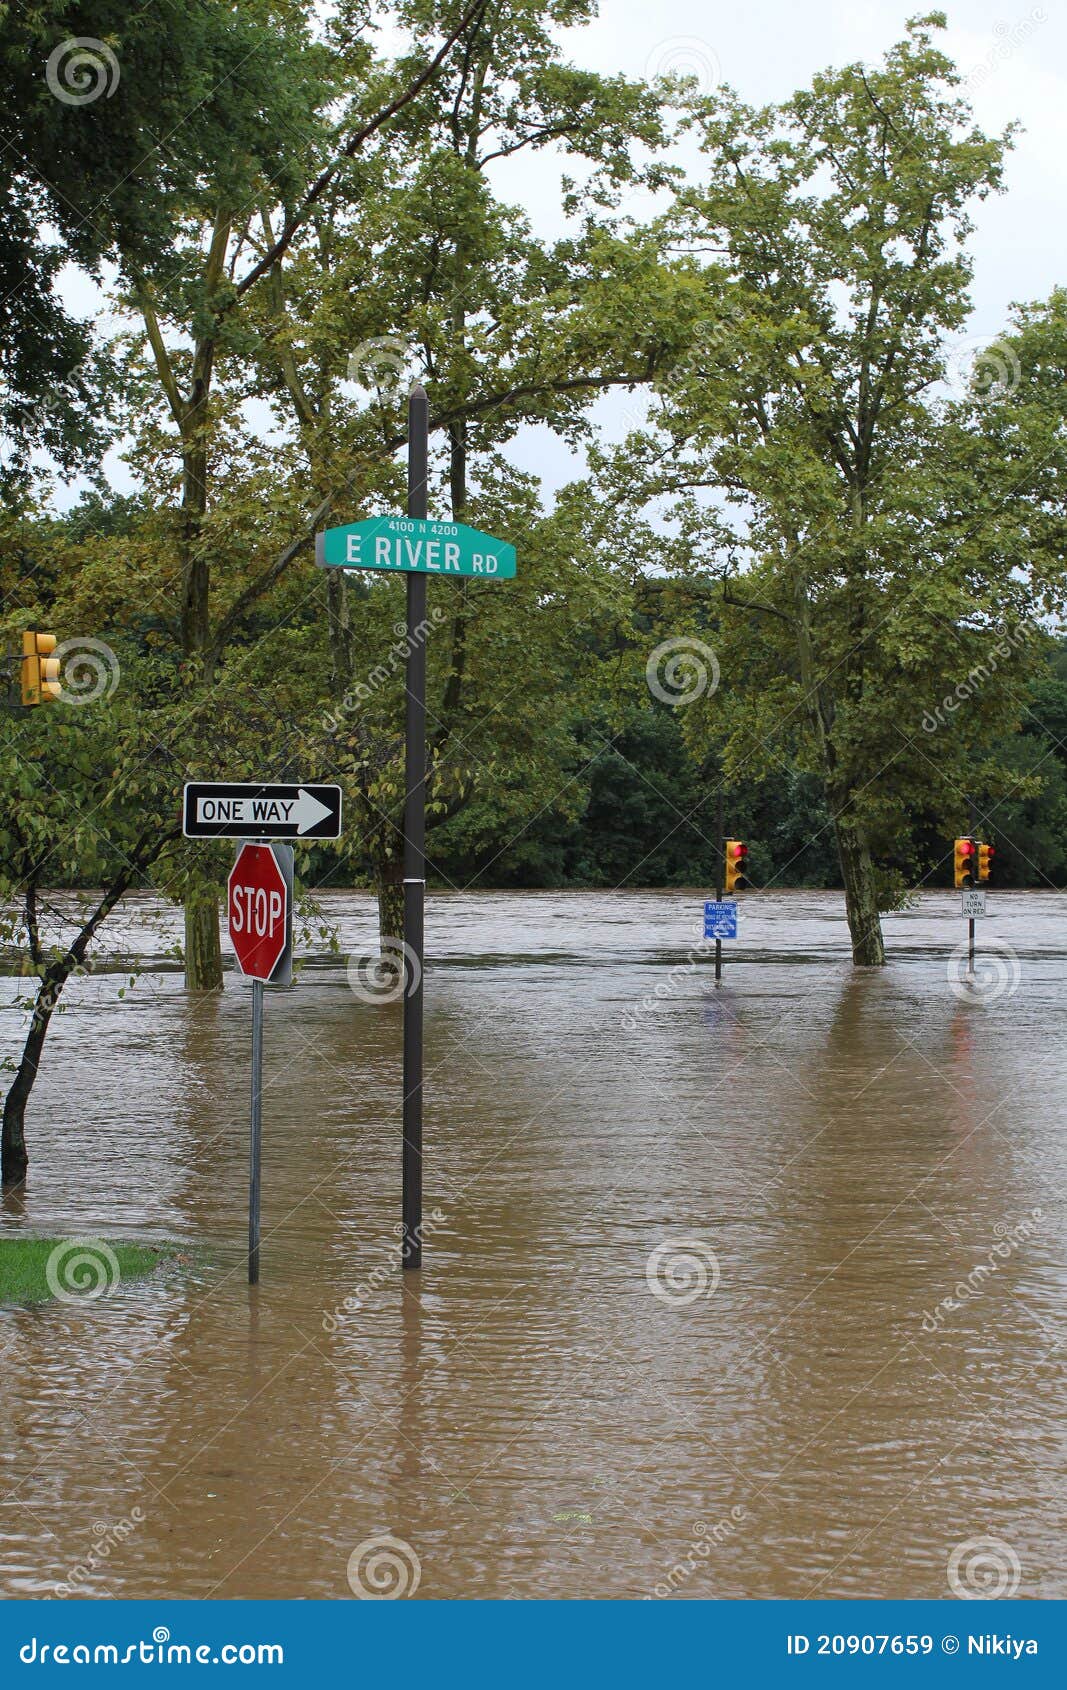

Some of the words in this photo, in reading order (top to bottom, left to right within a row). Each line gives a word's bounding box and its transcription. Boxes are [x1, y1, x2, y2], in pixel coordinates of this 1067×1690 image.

[388, 520, 415, 532] 4100
[419, 523, 426, 533] N
[431, 524, 458, 536] 4200
[346, 534, 362, 563] E
[375, 536, 461, 571] RIVER
[472, 553, 498, 574] RD
[202, 800, 244, 821] ONE
[252, 801, 294, 821] WAY
[231, 884, 282, 939] STOP
